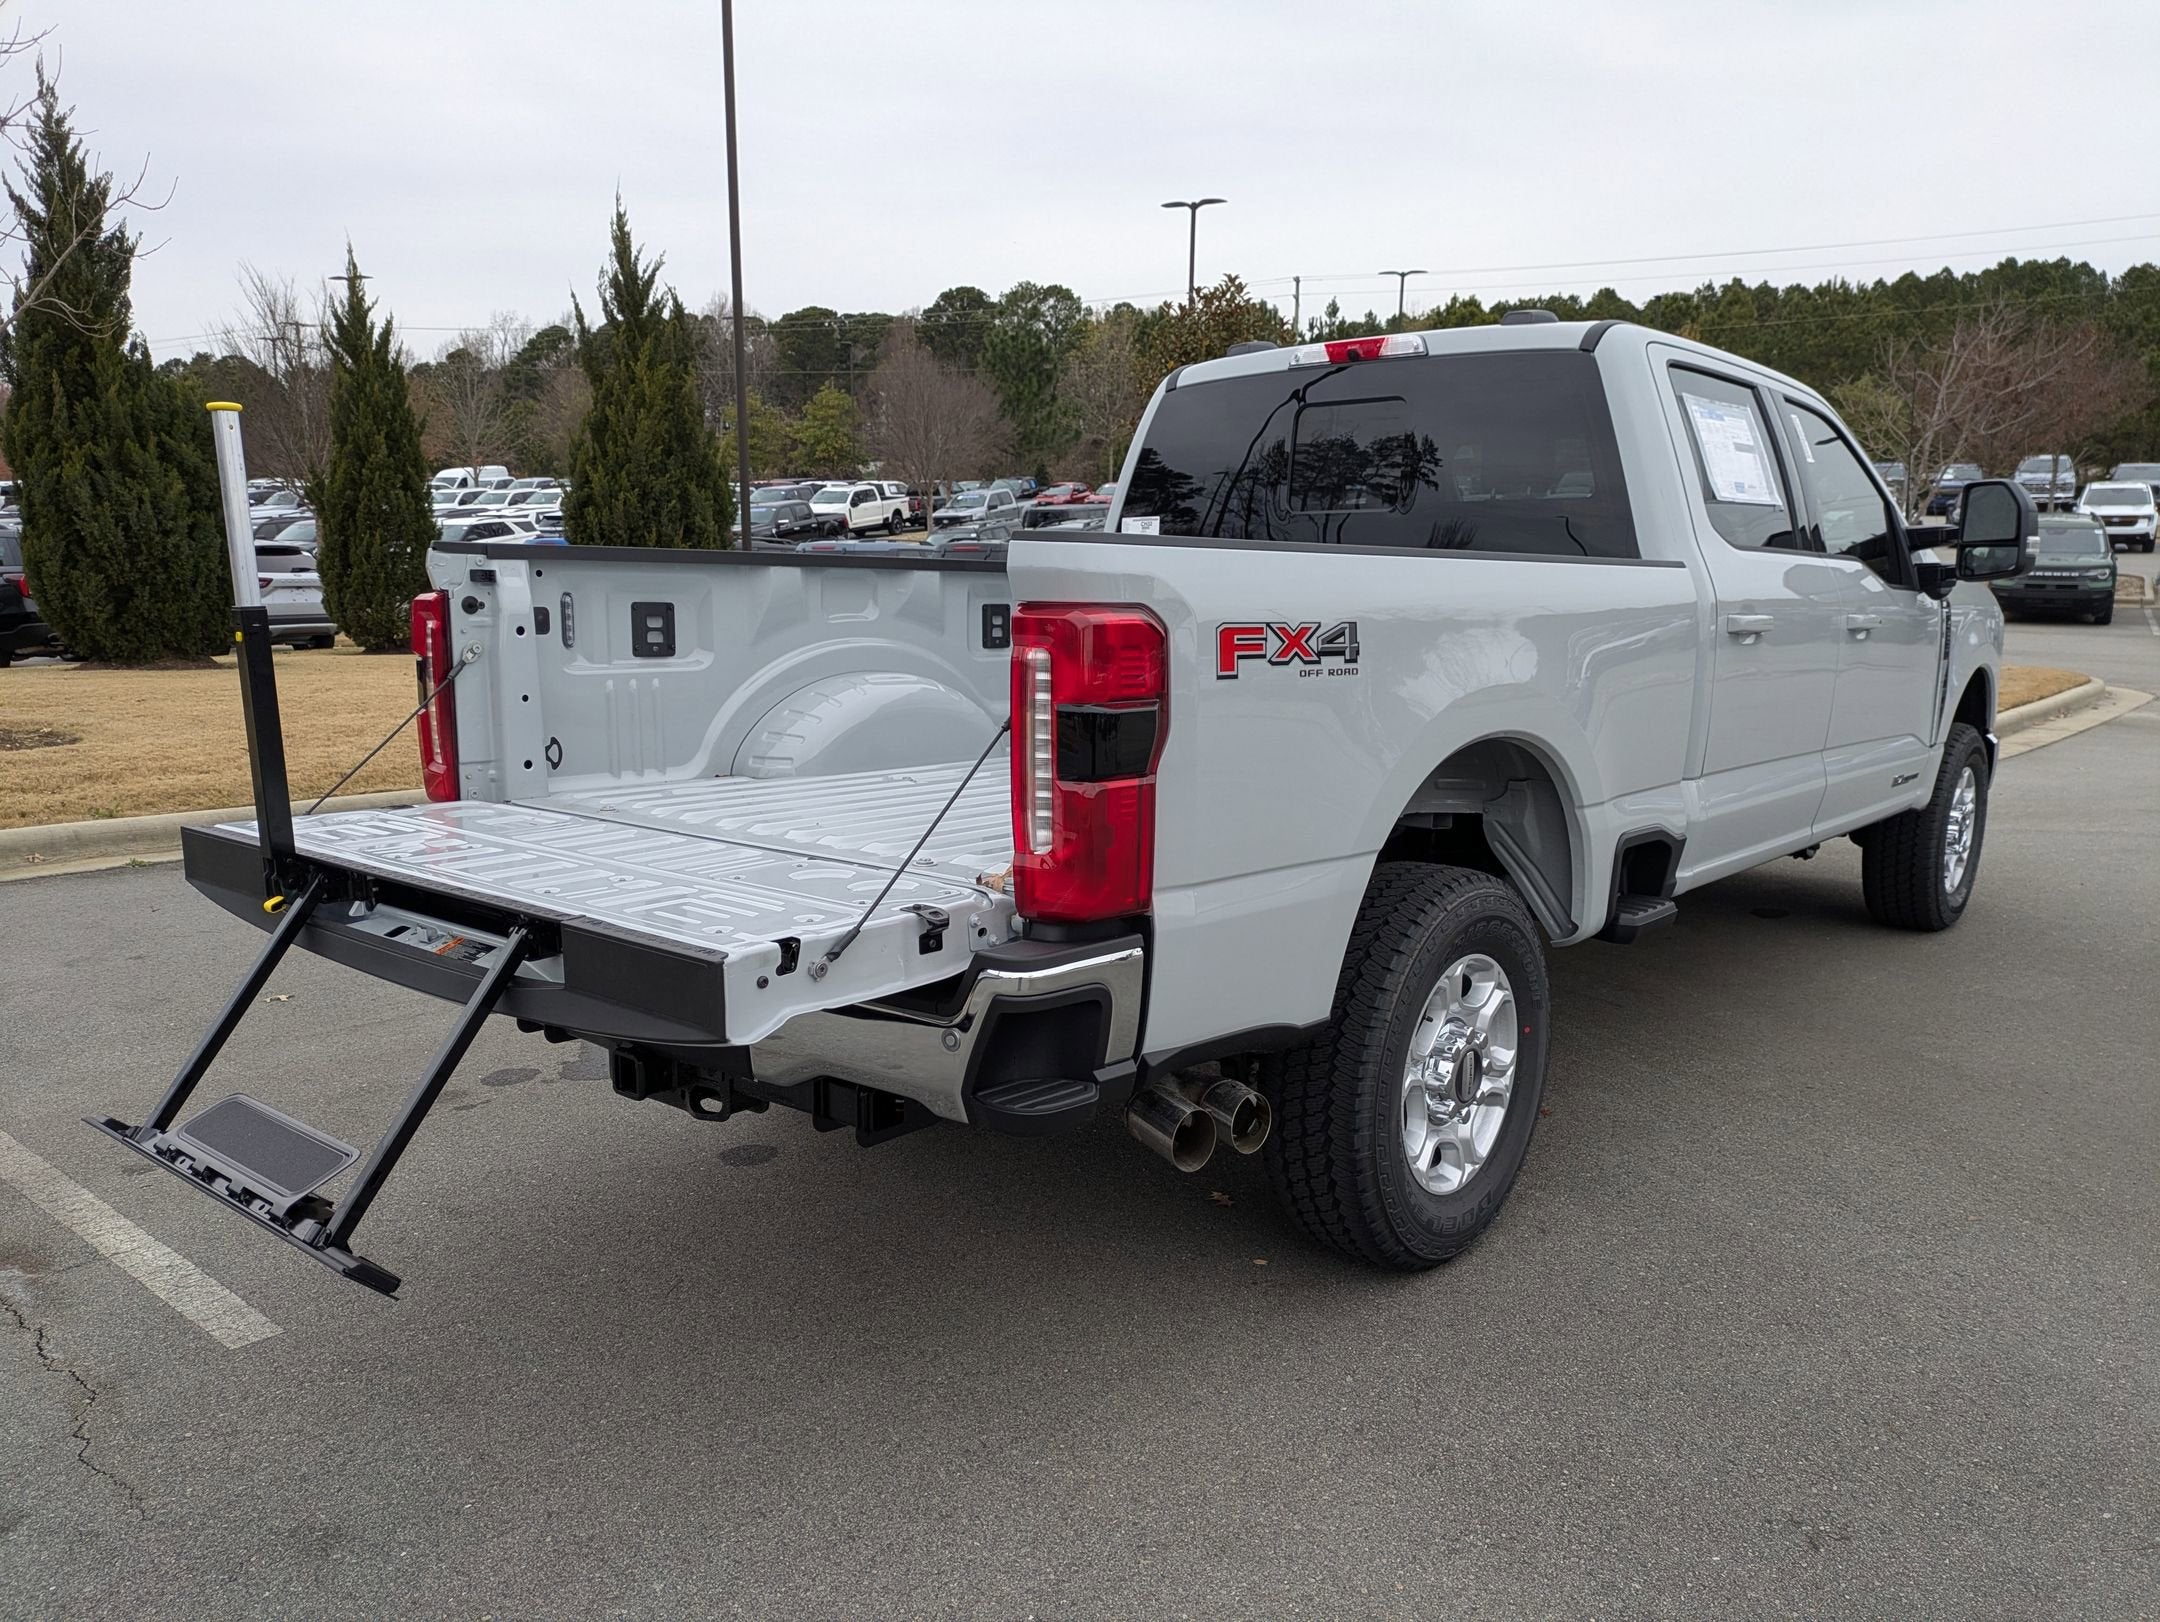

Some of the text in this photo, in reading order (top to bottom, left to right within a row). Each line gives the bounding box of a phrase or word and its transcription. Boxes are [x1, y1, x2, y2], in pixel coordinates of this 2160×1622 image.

[1216, 621, 1360, 680] FX4
[1299, 667, 1359, 678] OFF ROAD
